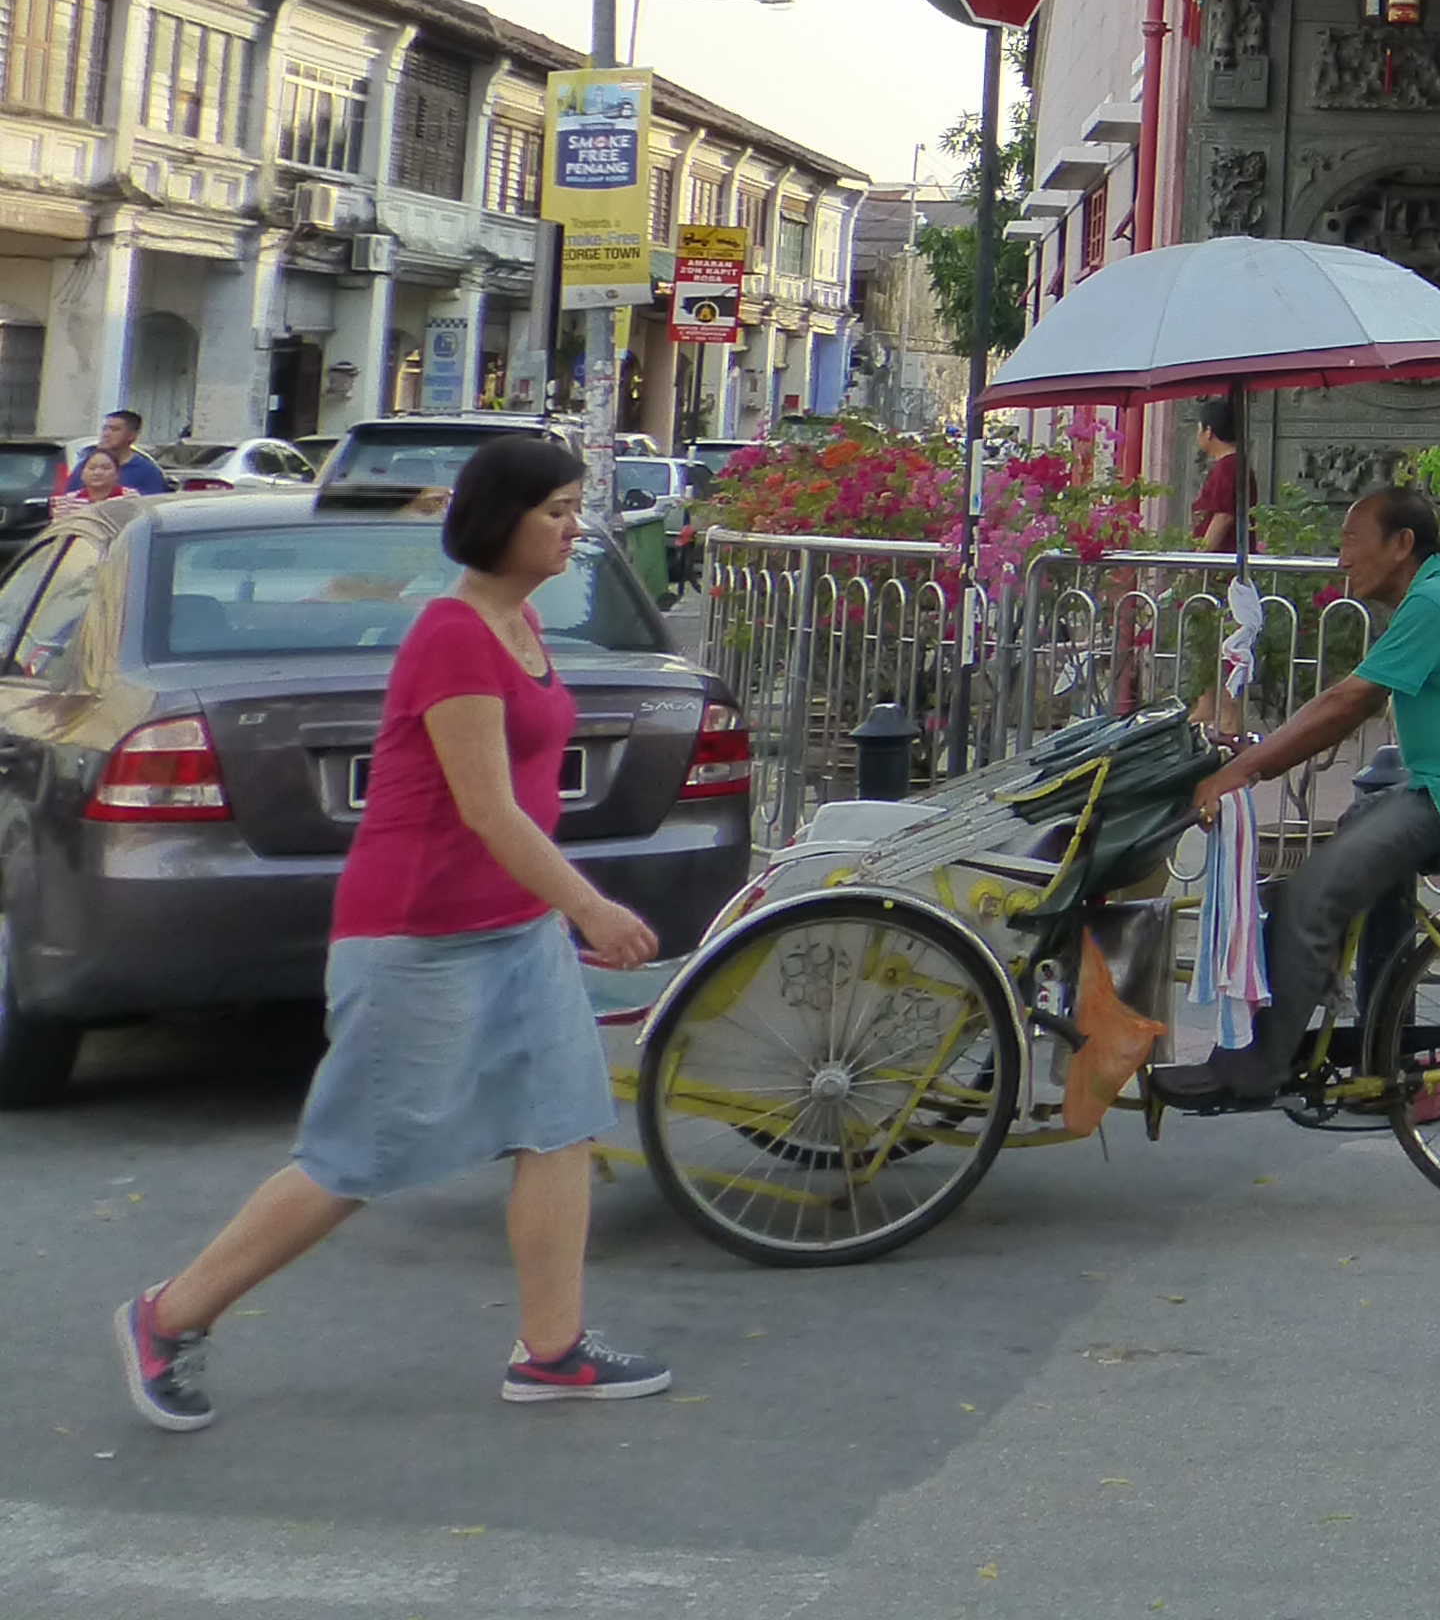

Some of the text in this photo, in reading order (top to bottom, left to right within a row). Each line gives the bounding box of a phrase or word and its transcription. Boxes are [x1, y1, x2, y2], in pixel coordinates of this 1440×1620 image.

[568, 135, 632, 149] SMOKE
[578, 149, 621, 162] FREE
[565, 162, 630, 174] PENANG
[565, 231, 640, 246] moke-Free
[563, 247, 641, 260] EORGE TOWN
[679, 266, 702, 274] ZON
[687, 259, 733, 268] AMARAN
[640, 699, 697, 712] SAGA
